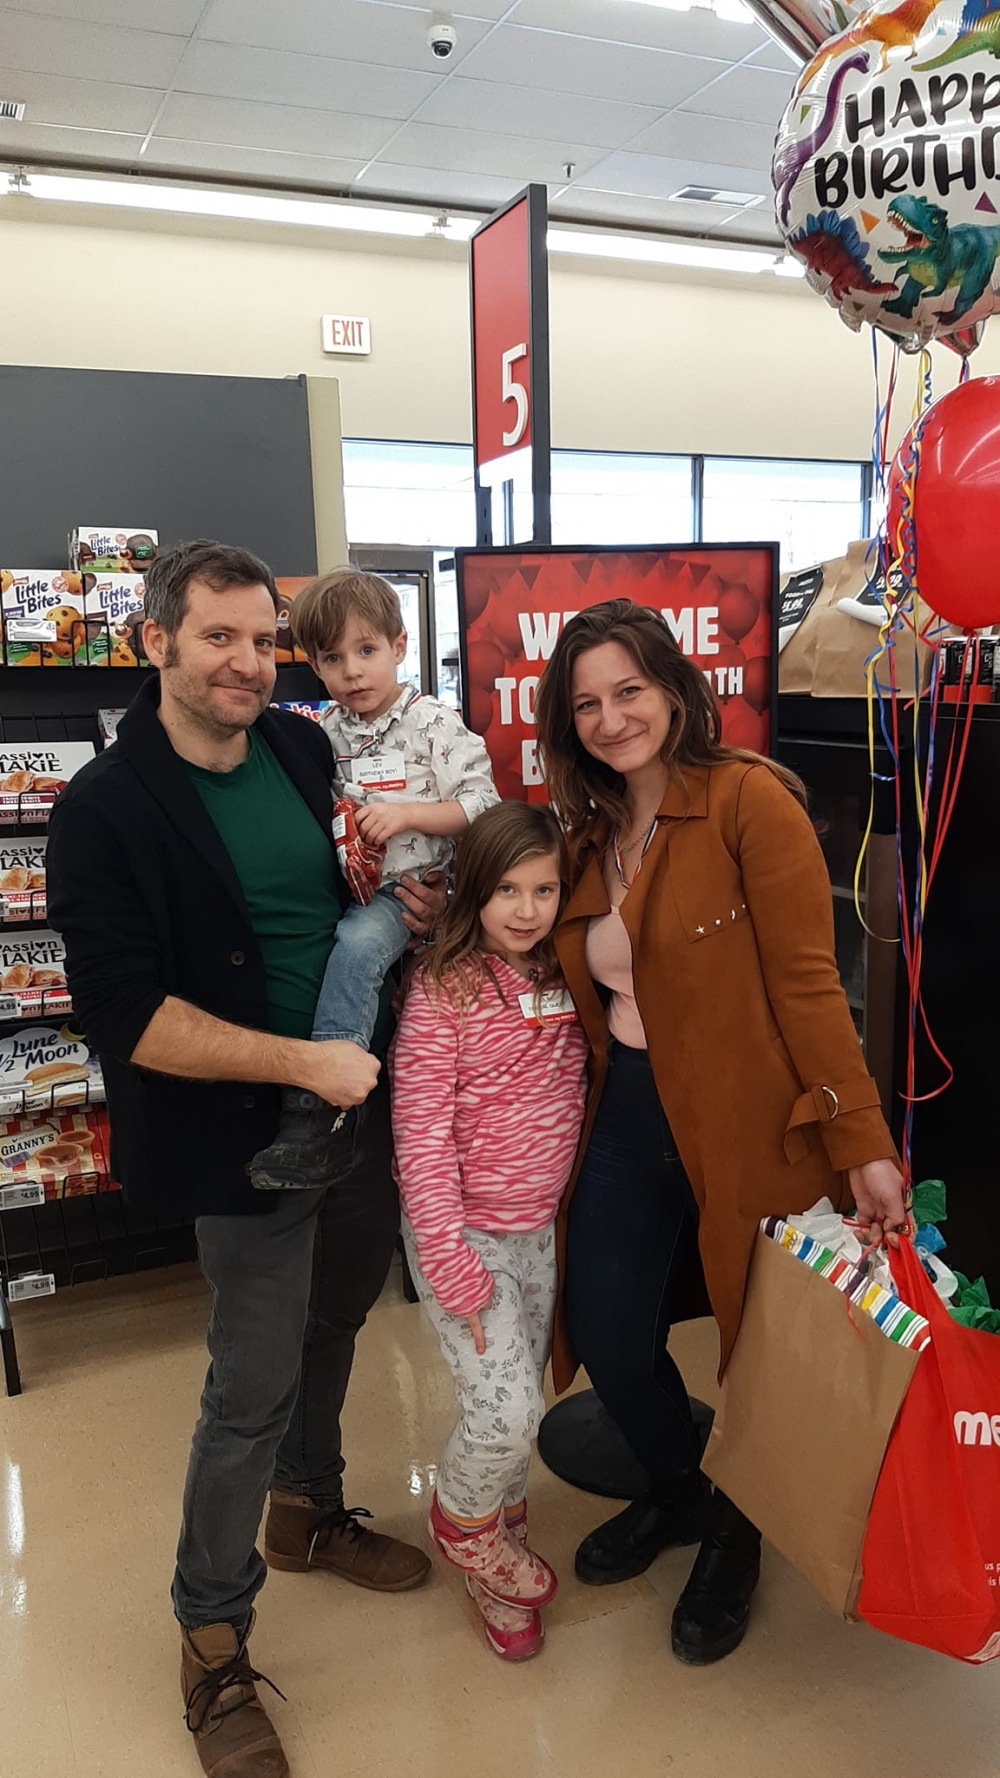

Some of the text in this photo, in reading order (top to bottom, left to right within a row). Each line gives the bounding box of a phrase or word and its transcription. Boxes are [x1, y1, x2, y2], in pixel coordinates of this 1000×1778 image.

[332, 319, 363, 347] EXIT
[503, 343, 529, 447] 5
[15, 580, 49, 604] Little
[27, 594, 62, 613] Bites
[99, 586, 131, 609] Little
[110, 600, 144, 618] Bites
[12, 1034, 59, 1058] Lune
[25, 1043, 80, 1070] Moon
[1, 1133, 55, 1156] GRANNY'S
